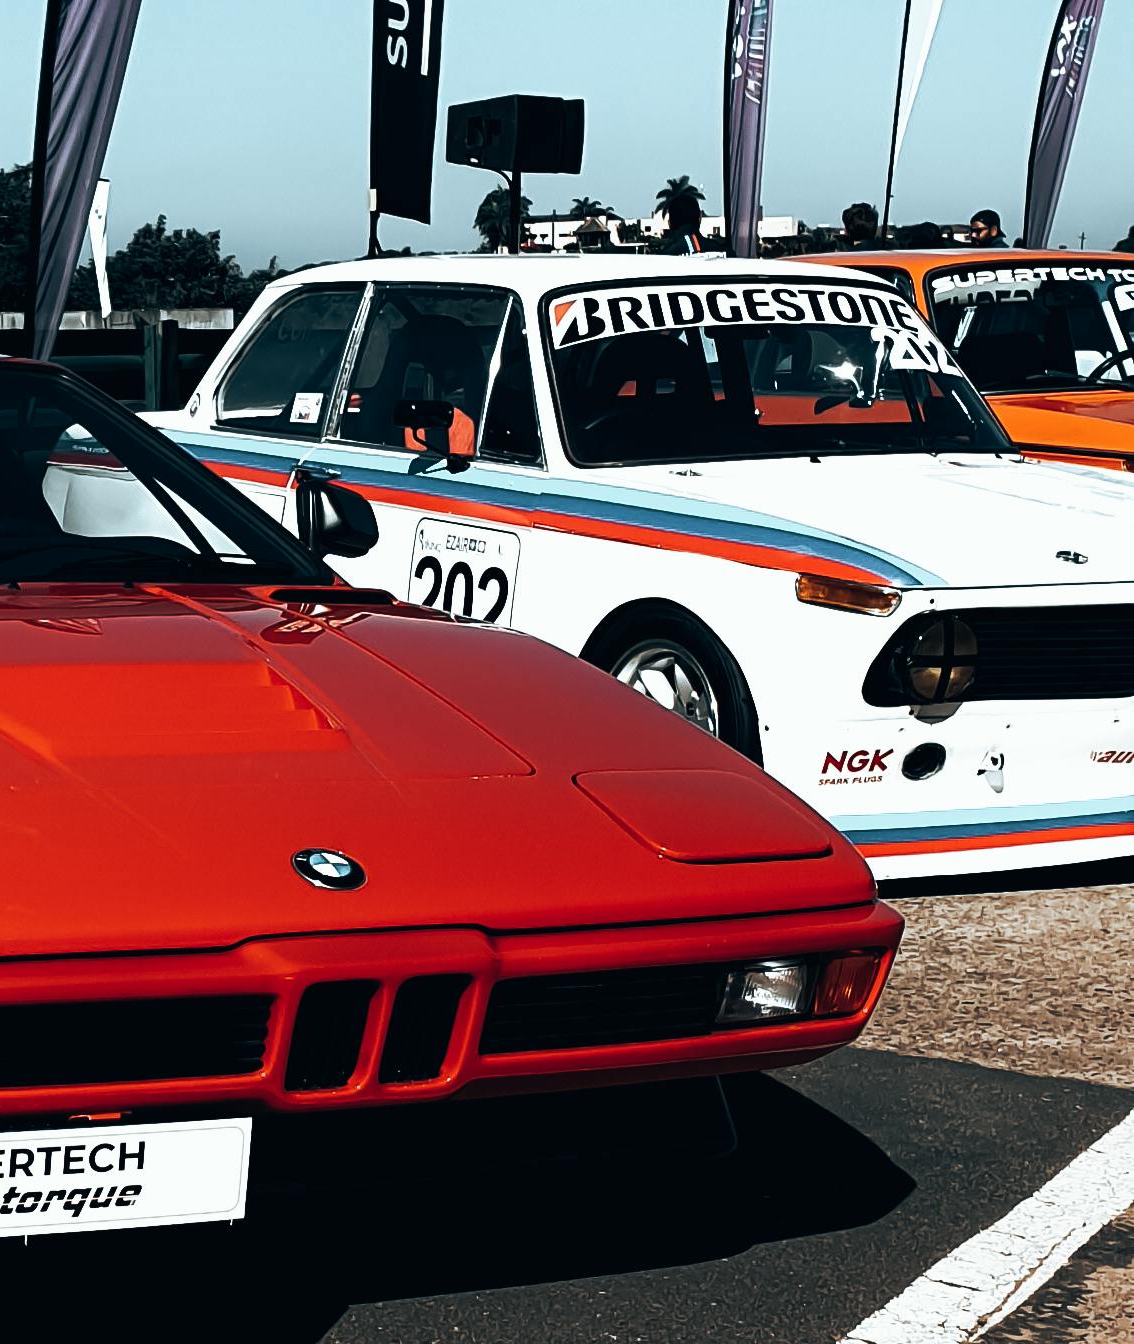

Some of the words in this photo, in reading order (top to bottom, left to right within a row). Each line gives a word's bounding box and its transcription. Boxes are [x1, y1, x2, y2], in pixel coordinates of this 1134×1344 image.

[931, 267, 1106, 290] SUPERTECH
[559, 289, 919, 347] BRIDGESTONE
[414, 555, 509, 624] 202
[821, 748, 895, 775] NGK
[0, 1182, 143, 1218] torque
